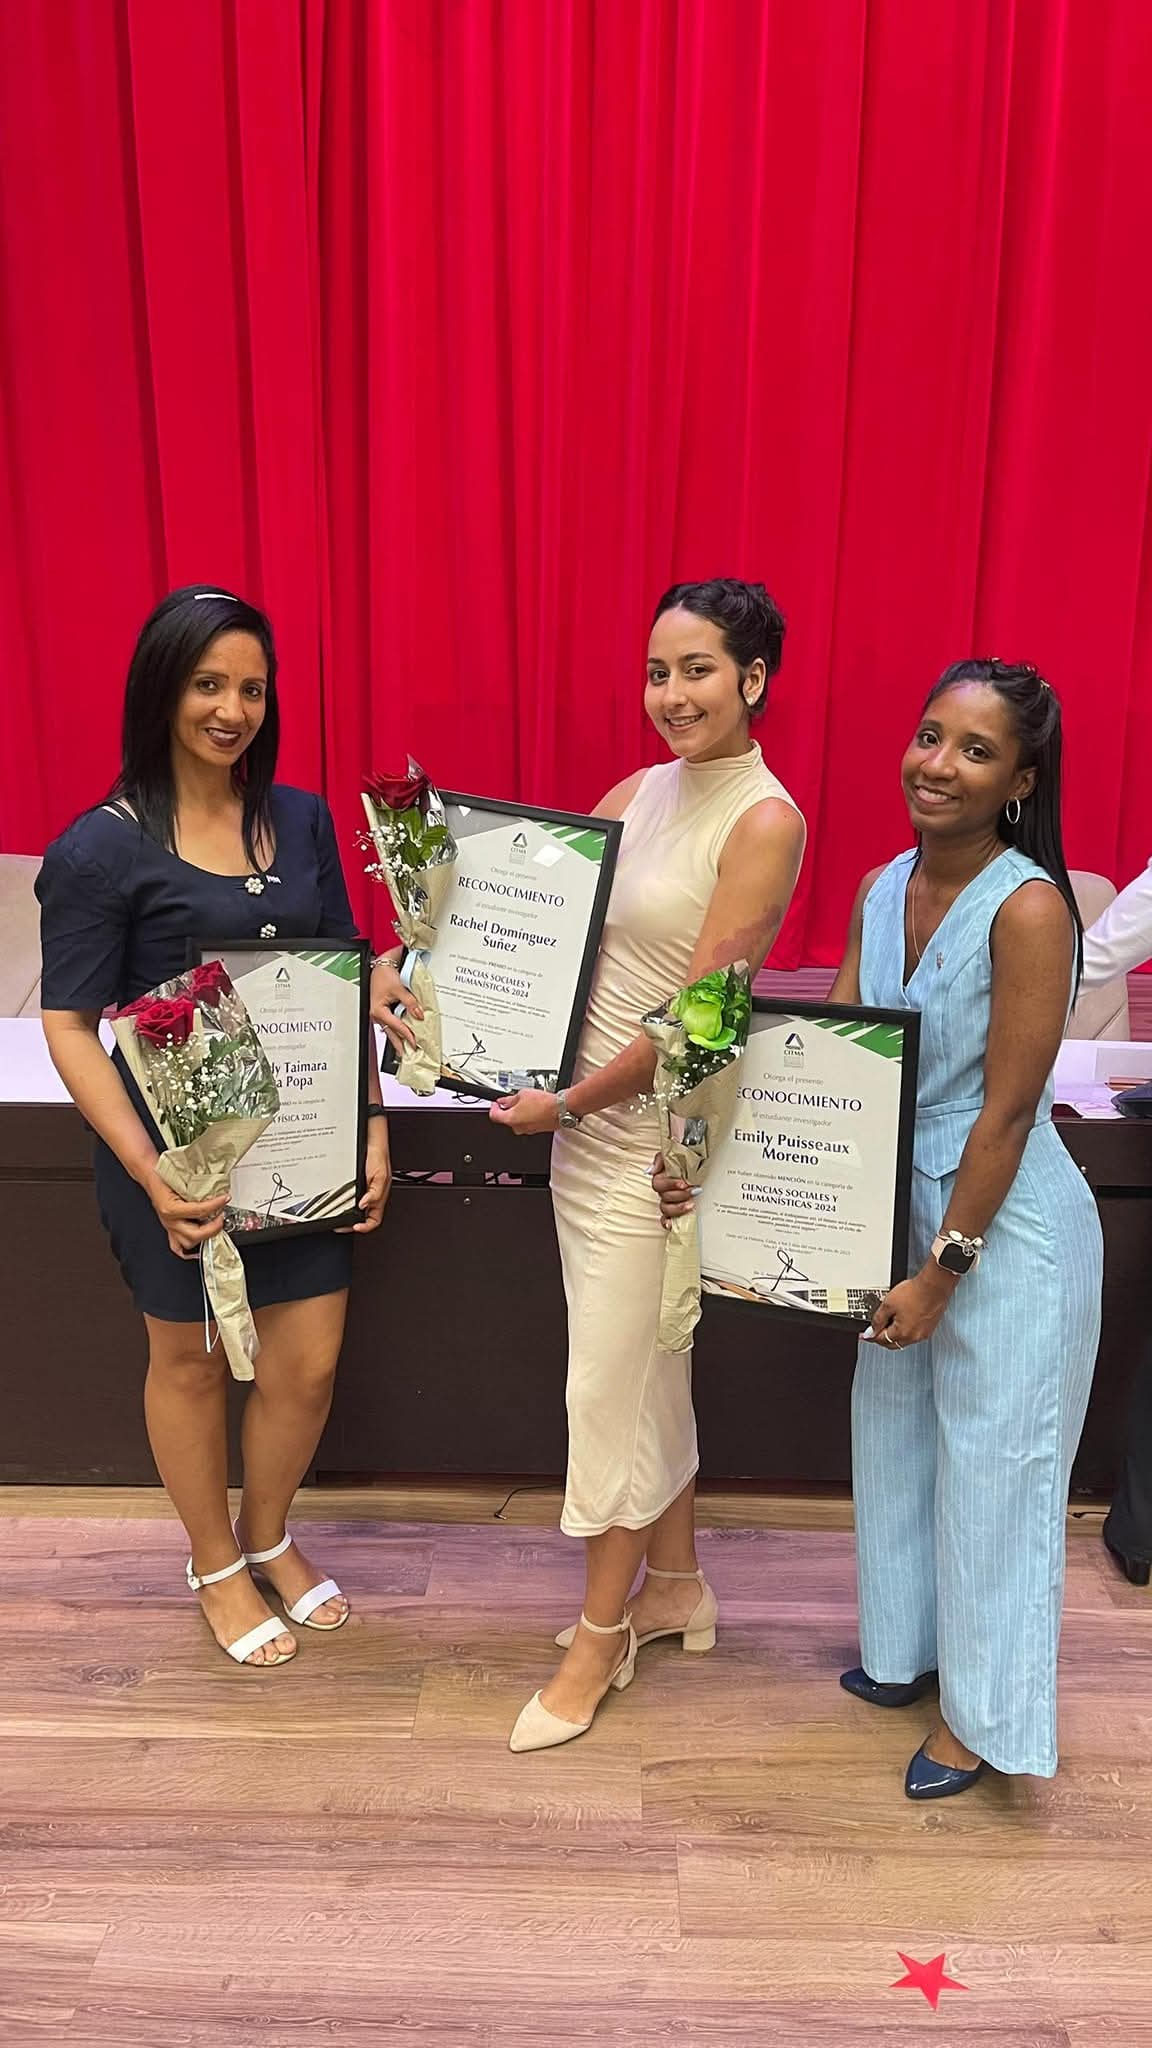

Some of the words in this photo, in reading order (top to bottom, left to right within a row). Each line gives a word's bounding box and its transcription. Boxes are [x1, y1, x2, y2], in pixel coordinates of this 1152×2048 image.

[458, 876, 565, 907] RECONOCIMIENTO
[450, 913, 488, 932] Rachel
[491, 923, 558, 947] Domínguez
[482, 936, 518, 953] Suñez
[455, 975, 510, 993] HUMANÍSTICAS
[512, 988, 529, 998] 2024
[456, 966, 489, 980] CIENCIAS
[490, 974, 525, 988] SOCIALES
[526, 981, 532, 989] Y
[254, 1020, 332, 1034] ONOCIMIENTO
[284, 1060, 327, 1073] Taimara
[286, 1075, 313, 1090] Popa
[736, 1086, 862, 1111] ECONOCIMIENTO
[301, 1112, 317, 1121] 2024
[734, 1128, 773, 1148] Emily
[778, 1134, 849, 1154] Puisseaux
[762, 1148, 819, 1165] Moreno
[741, 1183, 783, 1196] CIENCIAS
[785, 1189, 830, 1202] SOCIALES
[832, 1195, 839, 1203] Y
[742, 1193, 811, 1209] HUMANÍSTICAS
[815, 1202, 836, 1212] 2024
